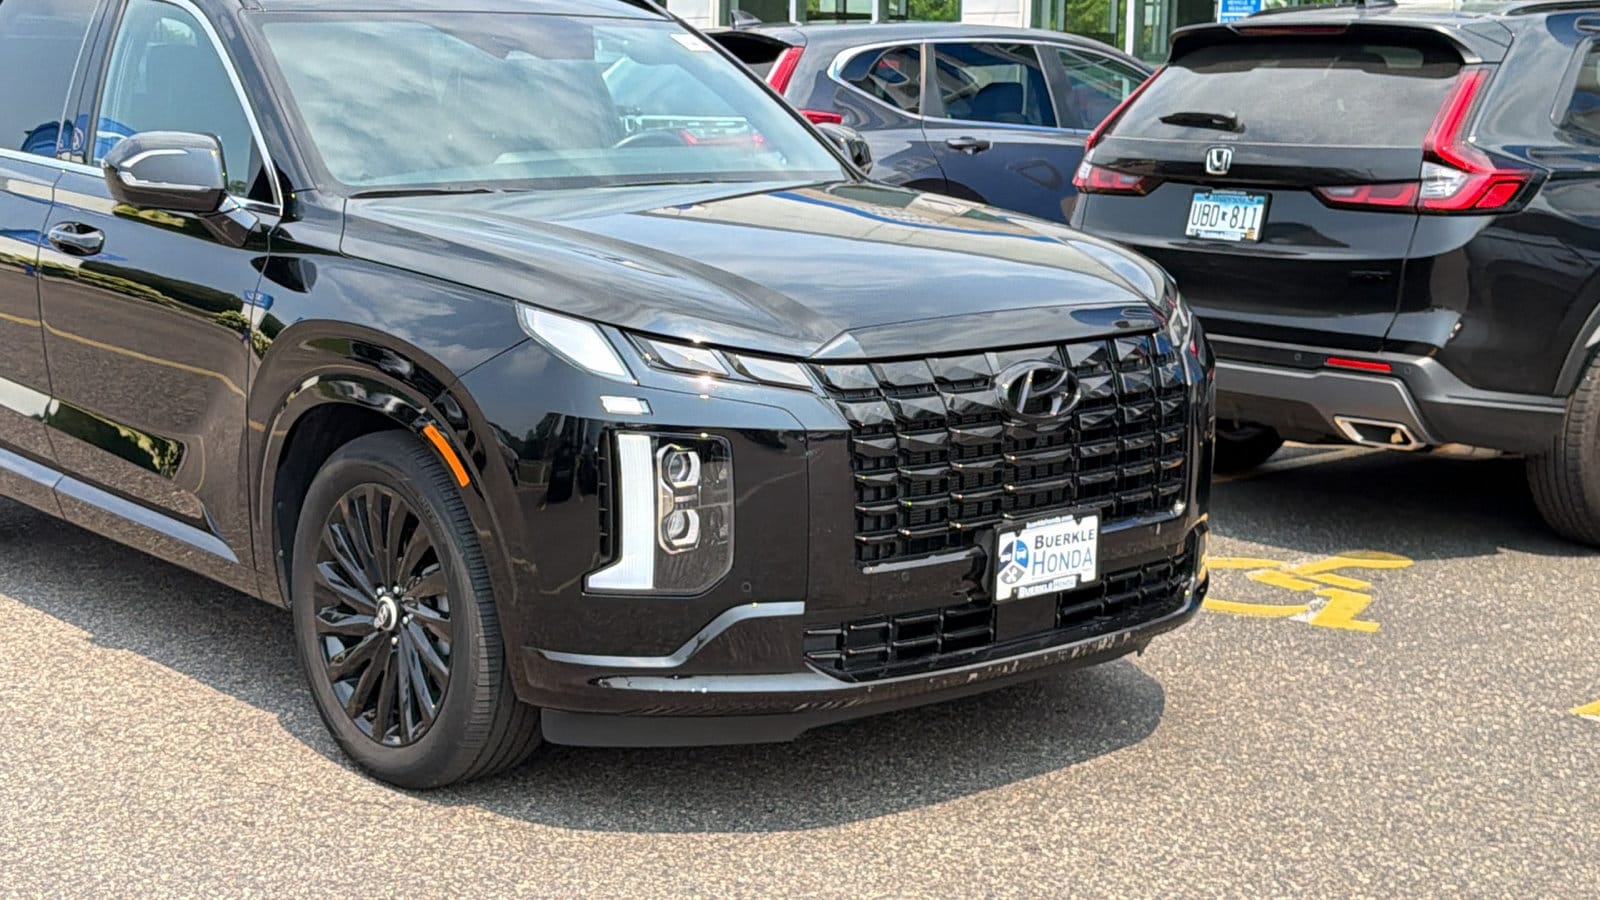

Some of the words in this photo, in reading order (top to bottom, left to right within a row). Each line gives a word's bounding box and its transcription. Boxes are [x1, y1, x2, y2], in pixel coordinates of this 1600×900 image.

[1229, 205, 1257, 230] 811
[1034, 529, 1095, 550] BUERKLE
[1032, 547, 1093, 576] HONDA
